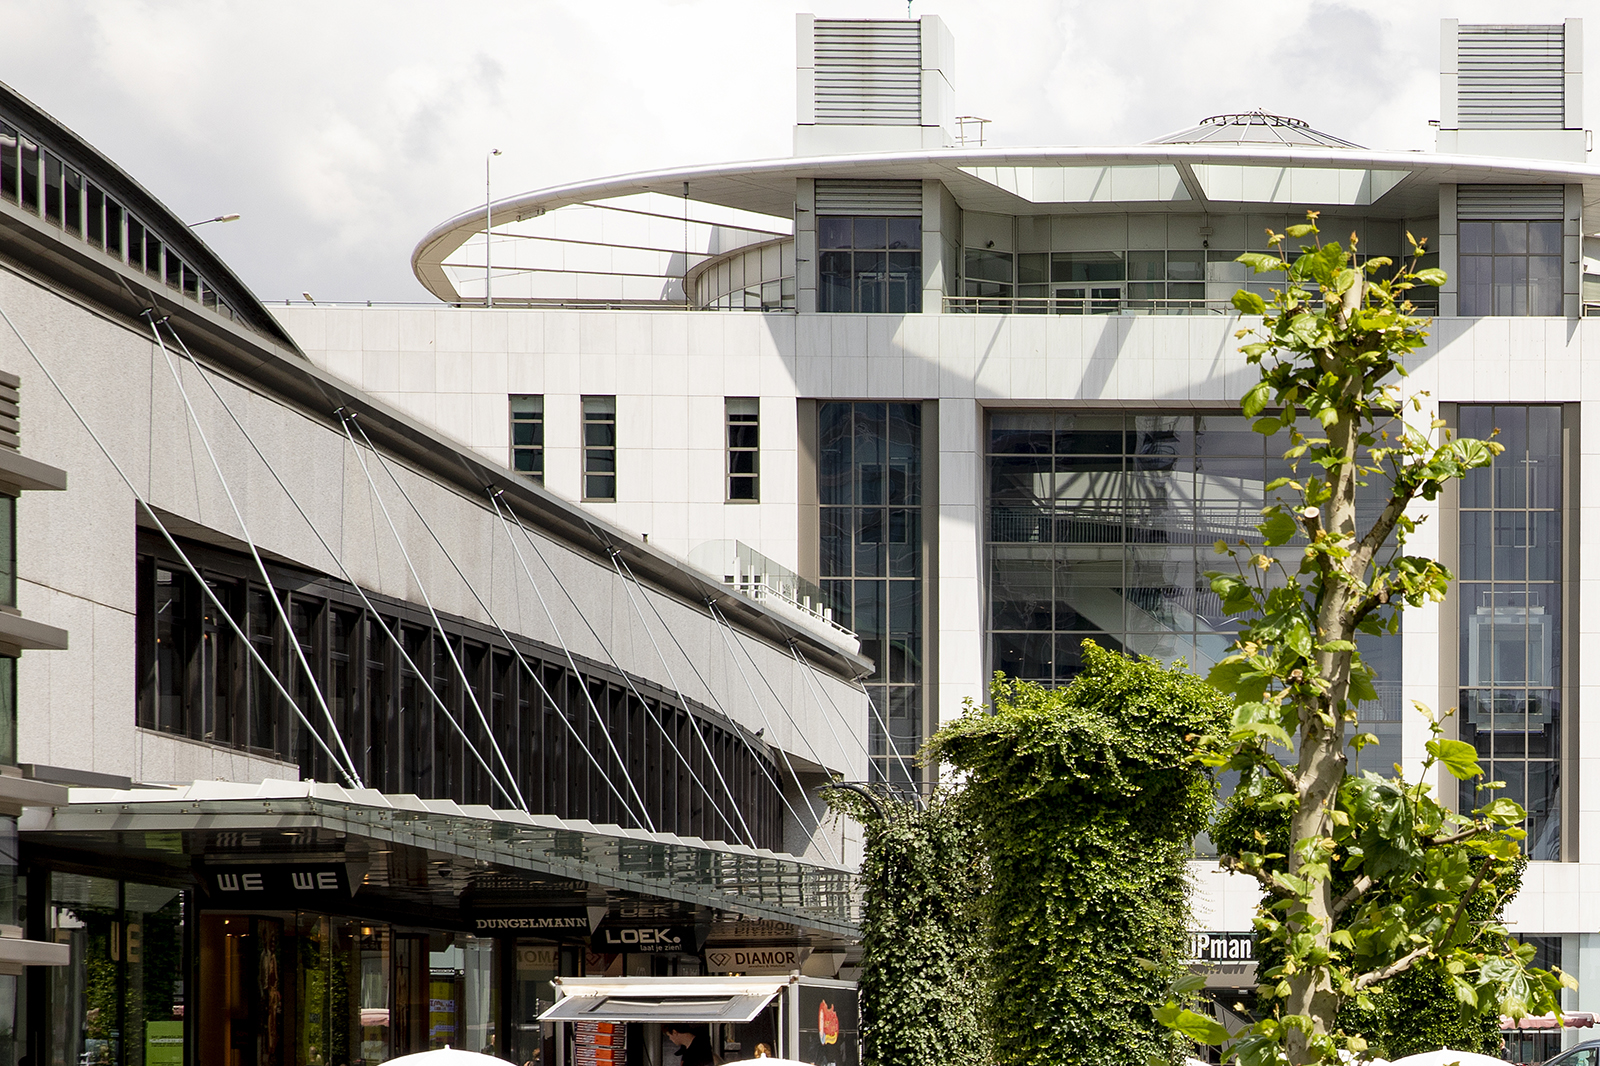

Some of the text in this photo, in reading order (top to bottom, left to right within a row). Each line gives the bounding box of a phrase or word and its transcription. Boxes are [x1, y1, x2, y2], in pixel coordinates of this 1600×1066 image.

[216, 871, 338, 891] WE WE
[476, 917, 588, 929] DUNGELMANN
[605, 928, 681, 944] LOEK.
[735, 951, 796, 965] DIAMOR
